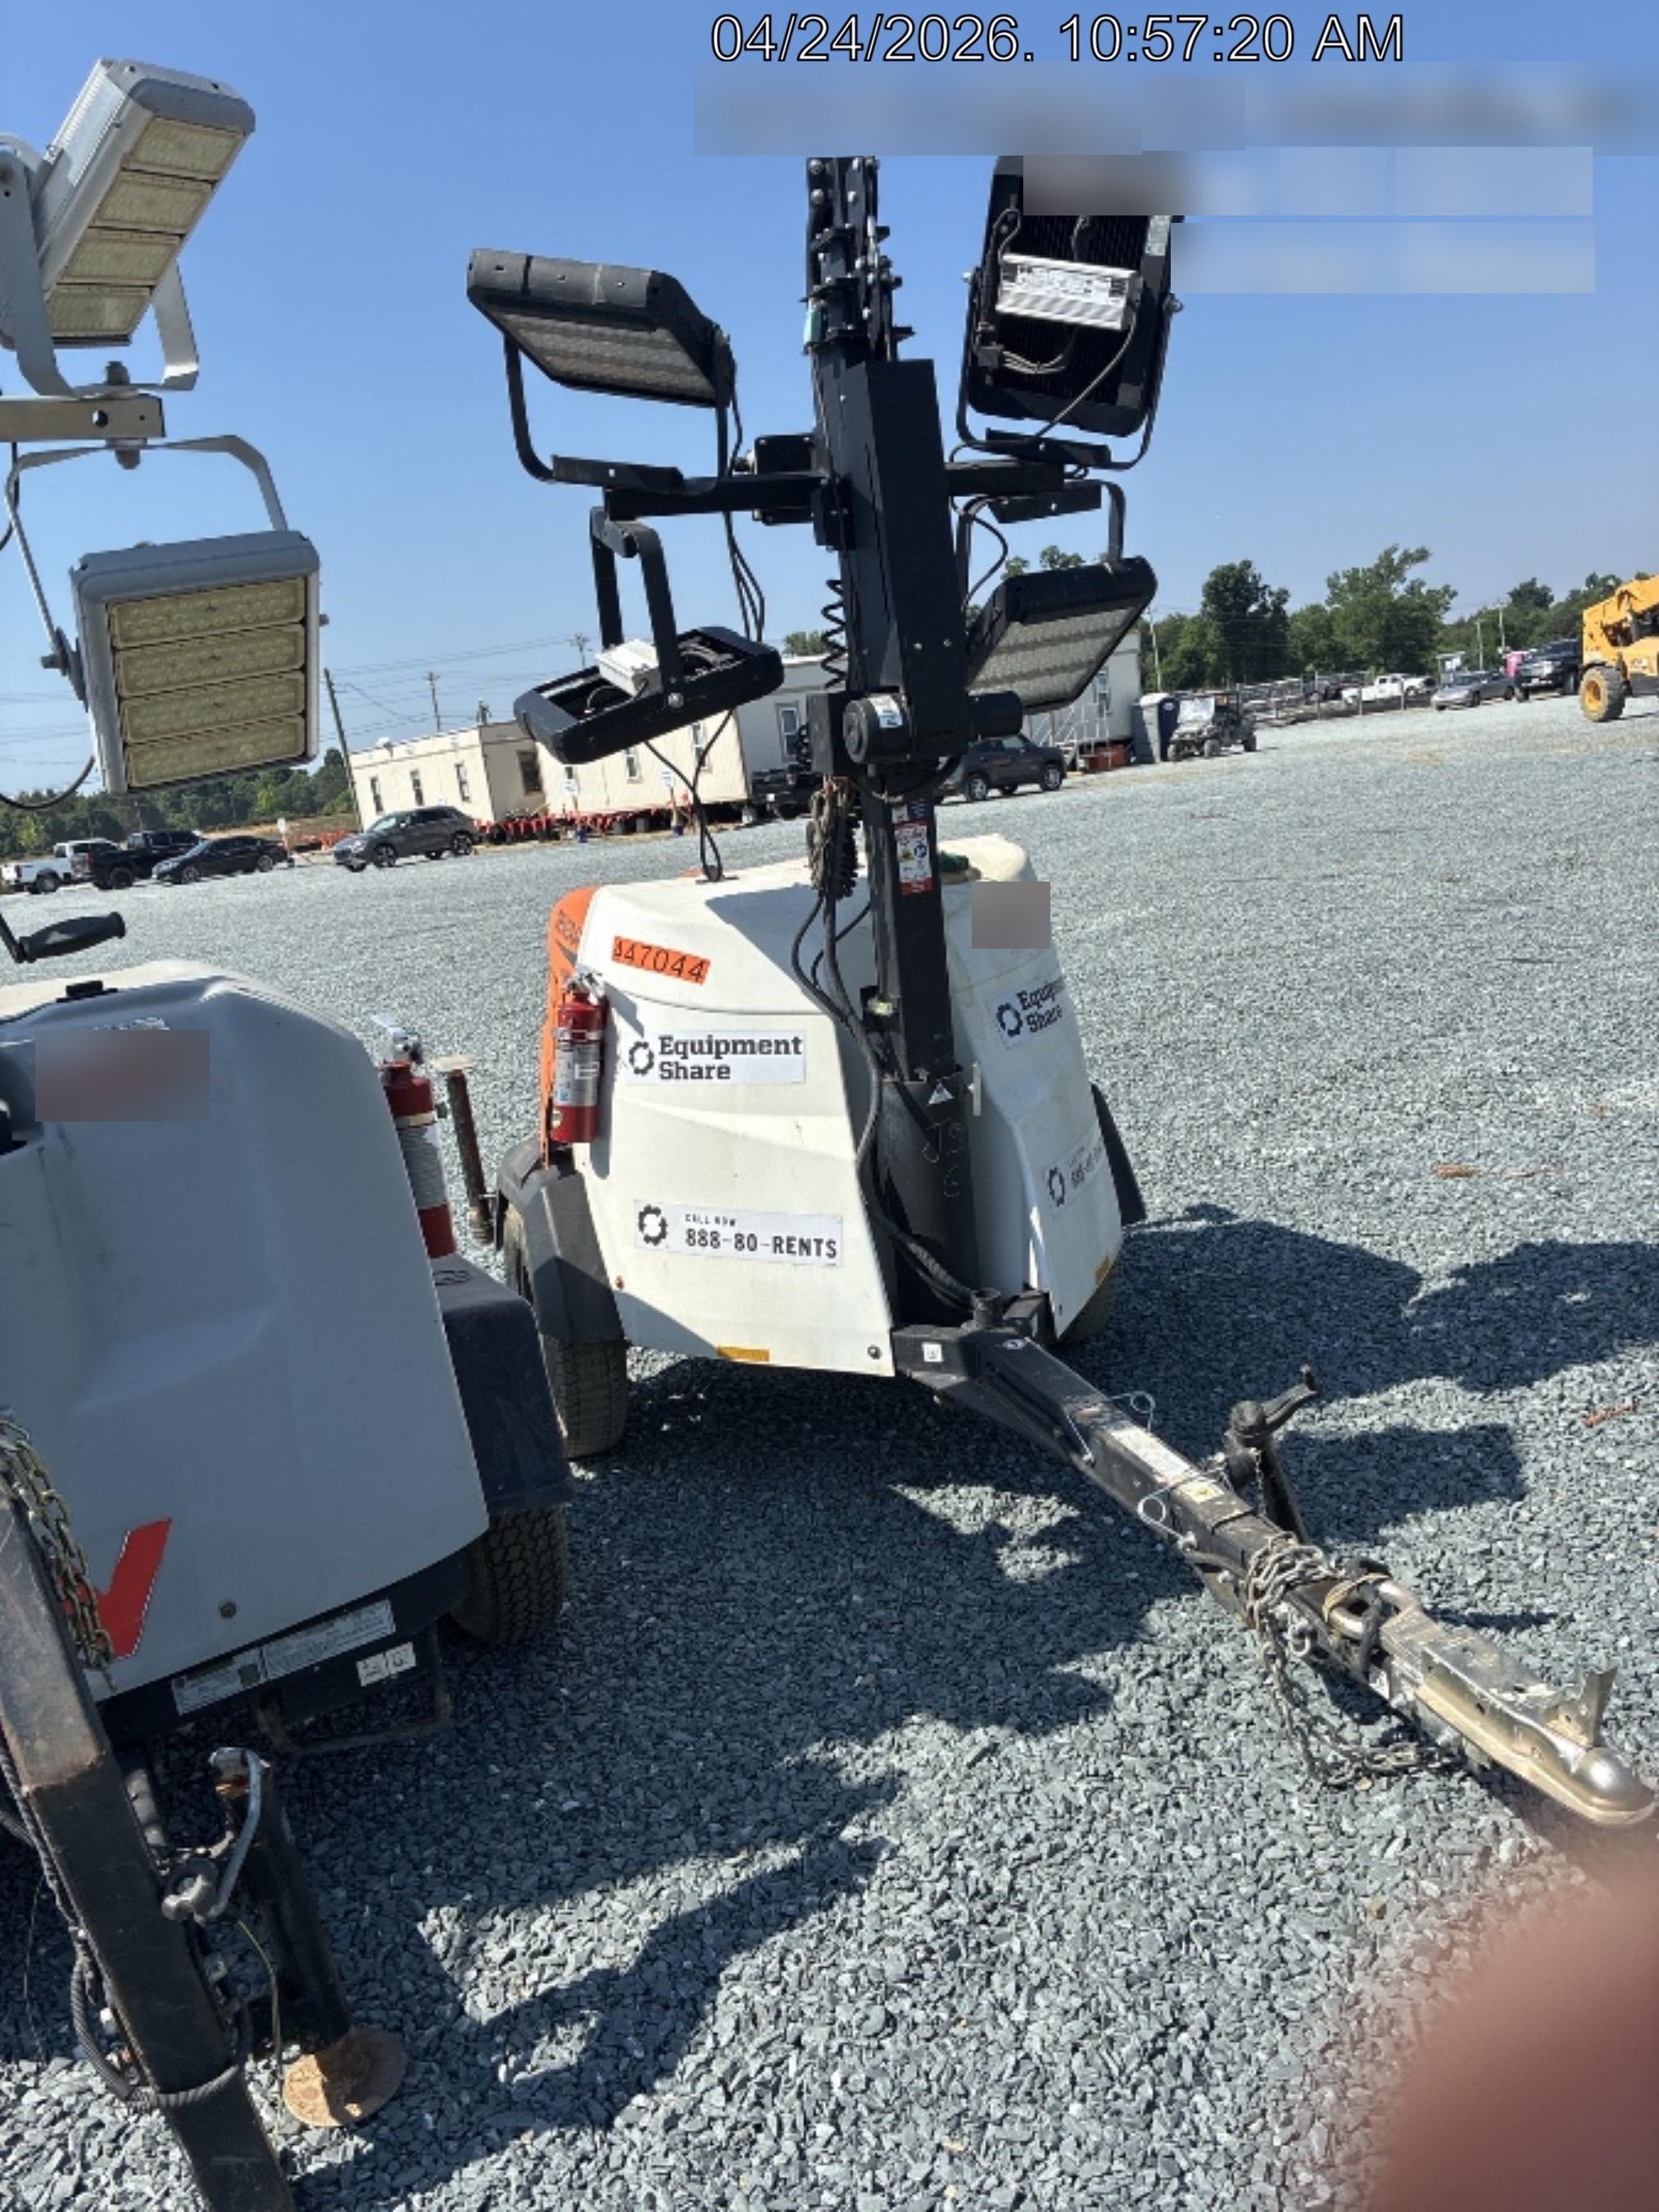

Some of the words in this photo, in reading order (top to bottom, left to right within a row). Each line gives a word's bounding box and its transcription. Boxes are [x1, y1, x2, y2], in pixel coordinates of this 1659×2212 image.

[659, 1035, 803, 1059] Equipment
[659, 1063, 731, 1081] Share
[685, 1228, 837, 1259] 888-80-RENTS
